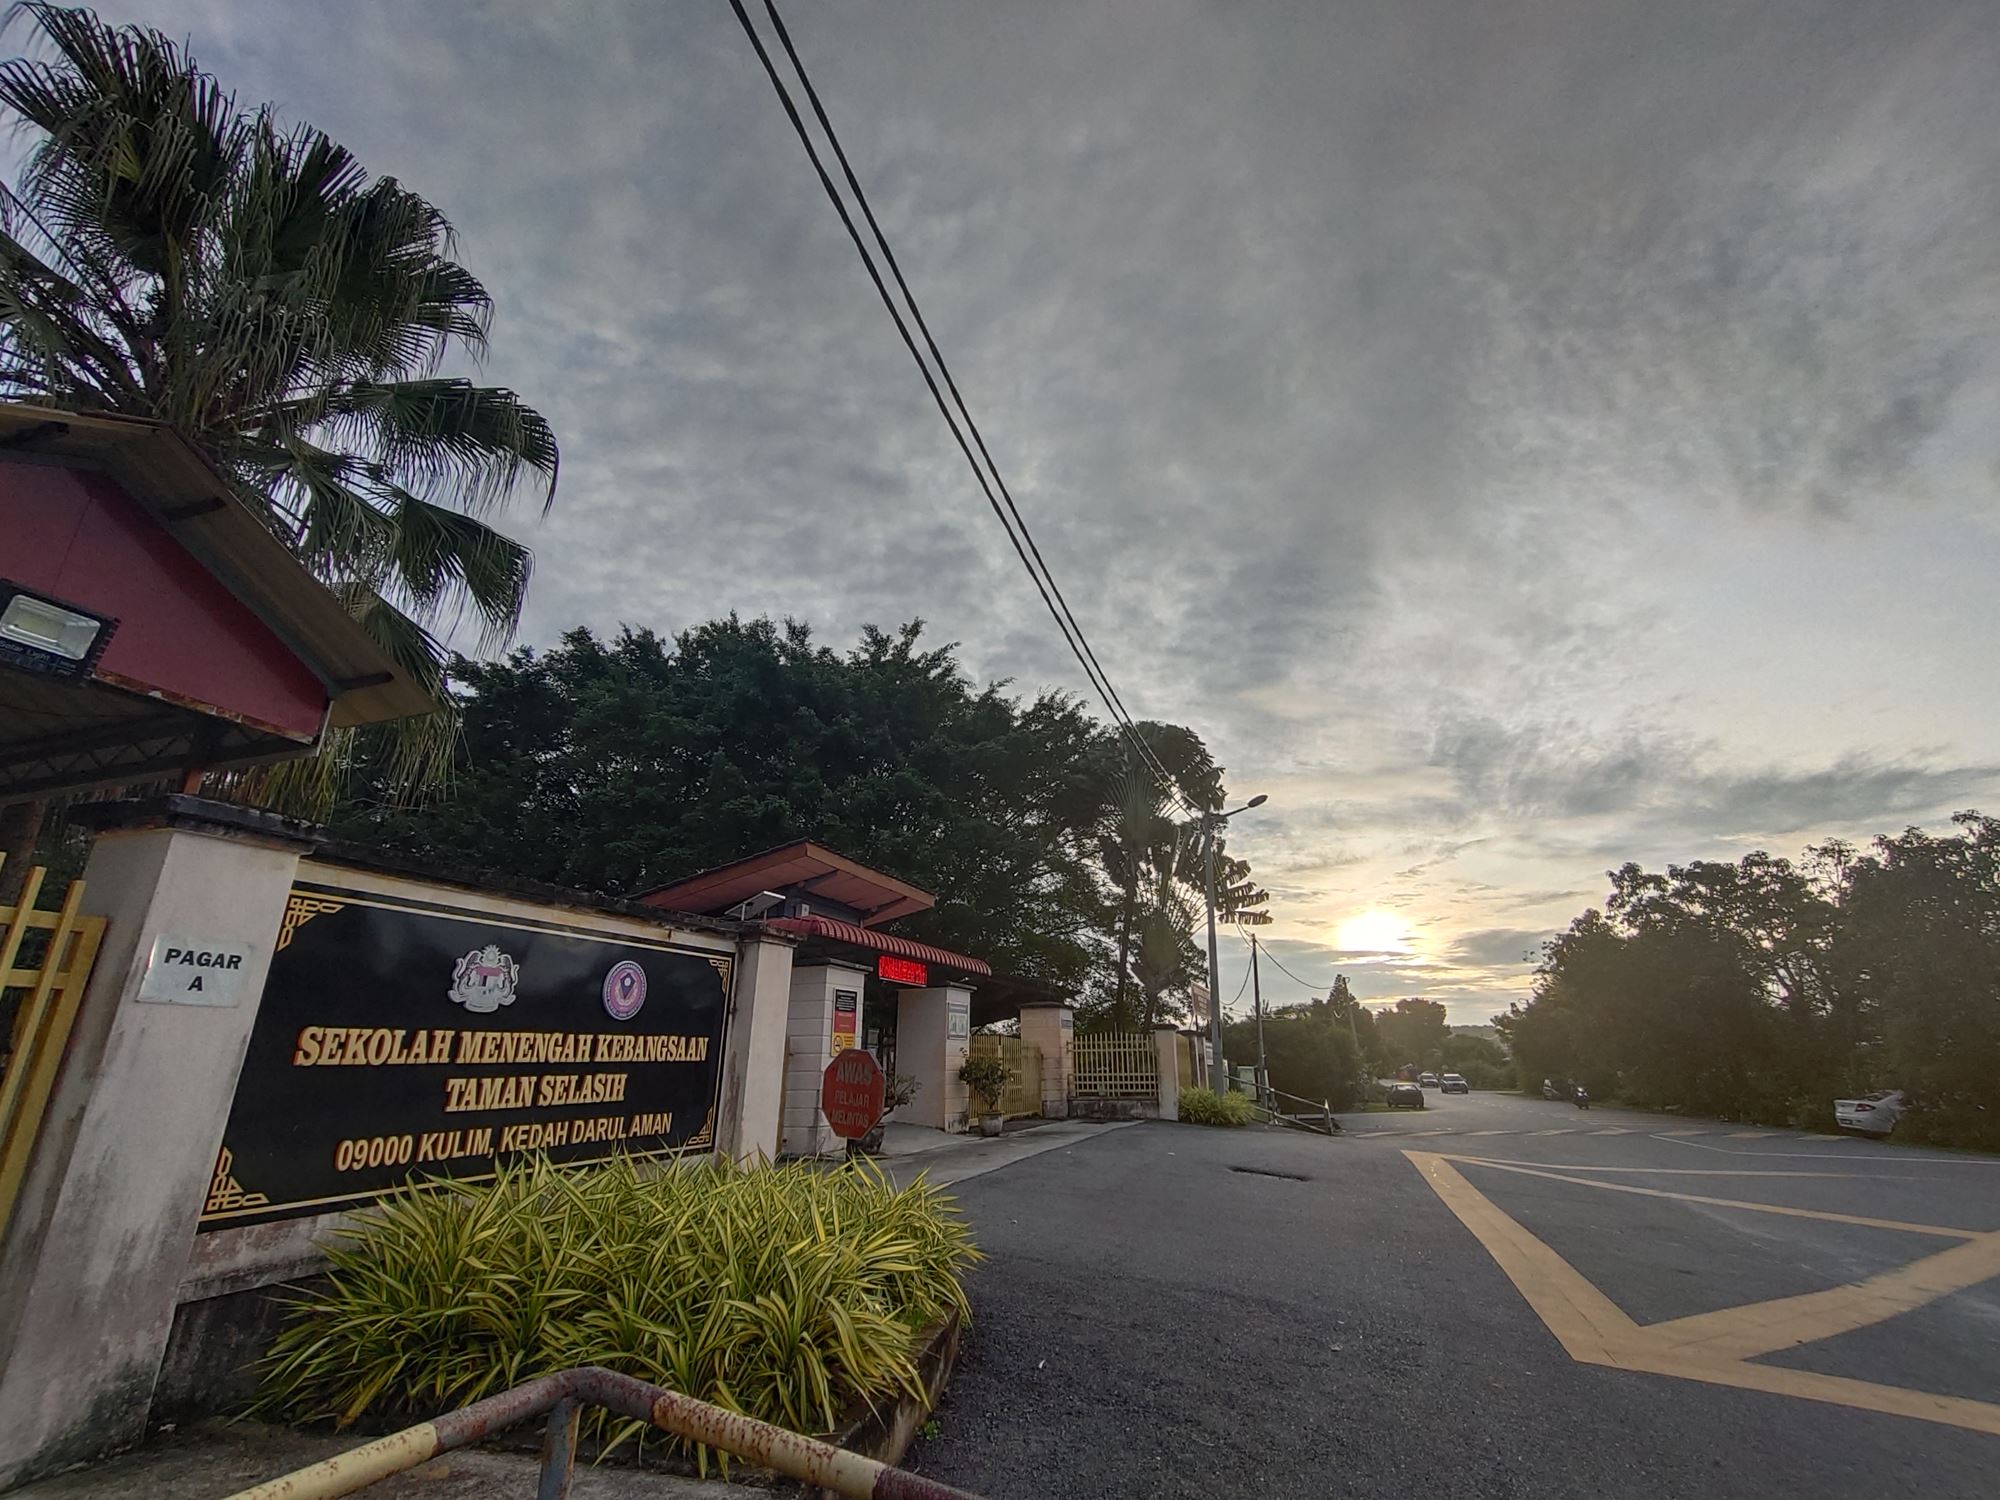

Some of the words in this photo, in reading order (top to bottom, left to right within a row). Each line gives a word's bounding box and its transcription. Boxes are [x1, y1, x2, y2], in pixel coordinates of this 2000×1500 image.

[164, 948, 242, 970] PAGAR
[187, 976, 203, 991] A
[294, 1026, 455, 1066] SEKOLAH
[455, 1030, 594, 1064] MENENGAH
[593, 1034, 709, 1062] KEBANGSAAN
[836, 1060, 872, 1086] AWAS
[444, 1076, 537, 1112] TAMAN
[538, 1073, 628, 1106] SELASIH
[834, 1089, 870, 1109] PELAJAR
[831, 1108, 870, 1129] MELINTAS
[335, 1134, 413, 1171] 09000
[415, 1127, 495, 1162] KULIM,
[500, 1120, 569, 1151] KEDAH
[571, 1116, 627, 1144] DARUL
[629, 1112, 673, 1137] AMAN
